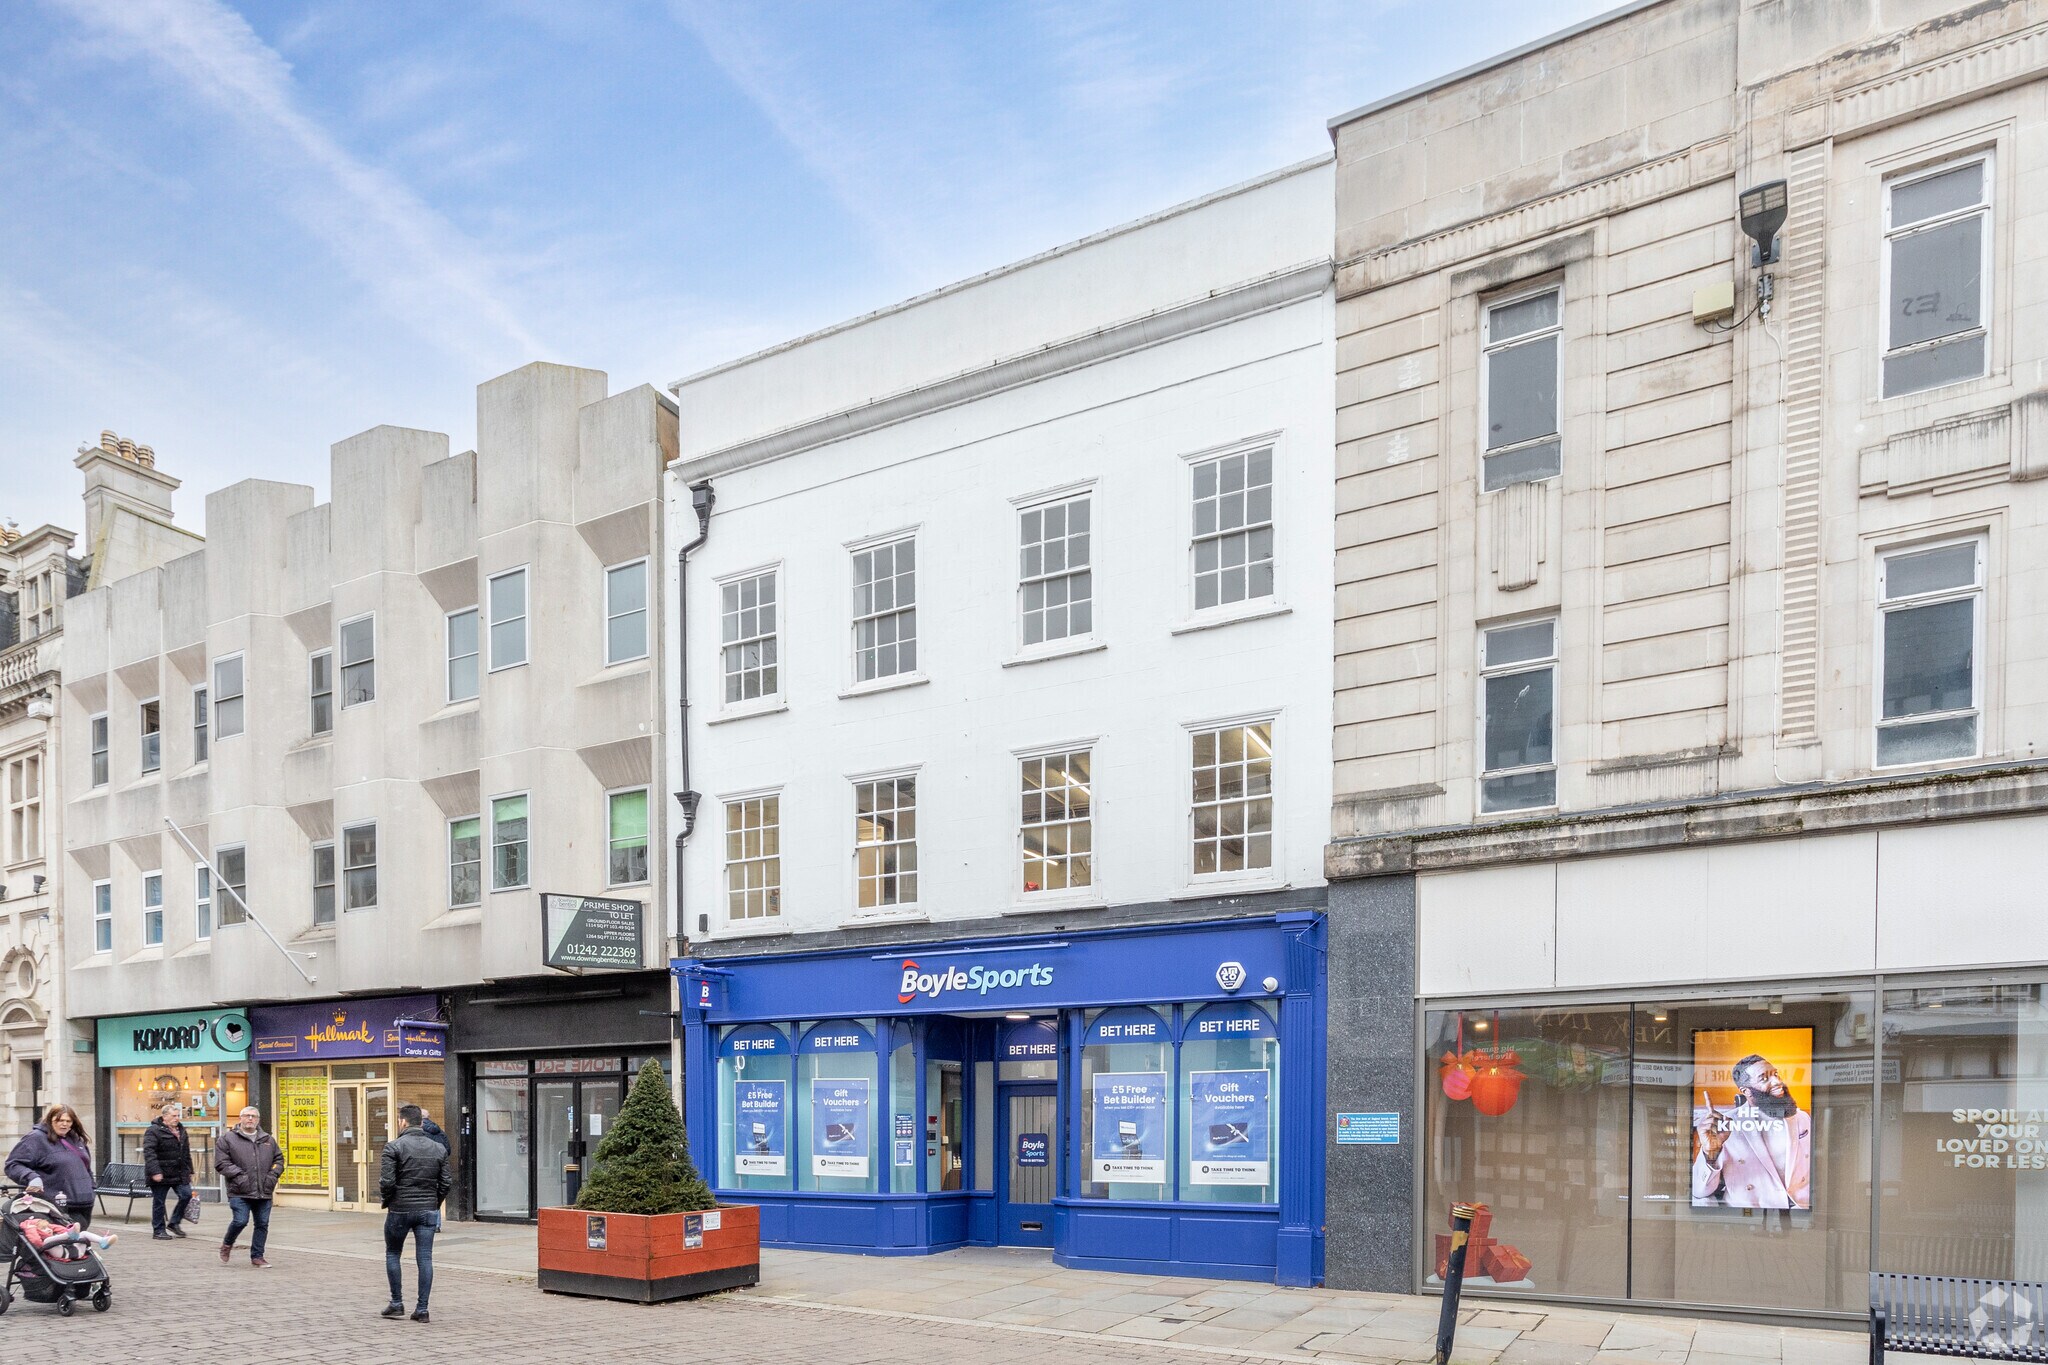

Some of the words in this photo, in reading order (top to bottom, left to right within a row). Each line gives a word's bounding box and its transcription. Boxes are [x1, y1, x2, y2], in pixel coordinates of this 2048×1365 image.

[584, 902, 610, 910] PRIME
[567, 944, 597, 955] 01242
[601, 946, 636, 958] 222369
[561, 955, 636, 964] www.downingbentley.co.uk
[900, 963, 1054, 997] BoyleSports
[702, 986, 709, 997] B
[1100, 1026, 1122, 1036] BET
[1124, 1024, 1156, 1035] HERE
[1200, 1021, 1223, 1032] BET
[1226, 1019, 1260, 1032] HERE
[133, 1026, 200, 1051] KOKORO
[304, 1020, 376, 1052] Hallmark
[405, 1034, 440, 1045] Hallmark
[814, 1037, 832, 1047] BET
[834, 1036, 859, 1046] HERE
[734, 1040, 750, 1050] BET
[752, 1039, 775, 1049] HERE
[1009, 1045, 1027, 1055] BET
[1030, 1044, 1056, 1054] HERE
[834, 1089, 848, 1097] Gift
[1220, 1083, 1239, 1093] Gift
[1104, 1095, 1119, 1104] Bet
[1121, 1095, 1156, 1104] Builder
[1205, 1094, 1254, 1103] Vouchers
[1738, 1106, 1759, 1118] HE
[1952, 1109, 2019, 1124] SPOIL
[2025, 1109, 2048, 1123] A
[1717, 1120, 1784, 1132] KNOWS
[1975, 1124, 2039, 1138] YOUR
[1023, 1141, 1044, 1150] Boyle
[1936, 1139, 2009, 1152] LOVED
[1954, 1154, 2000, 1168] FOR
[2007, 1154, 2048, 1169] LES
